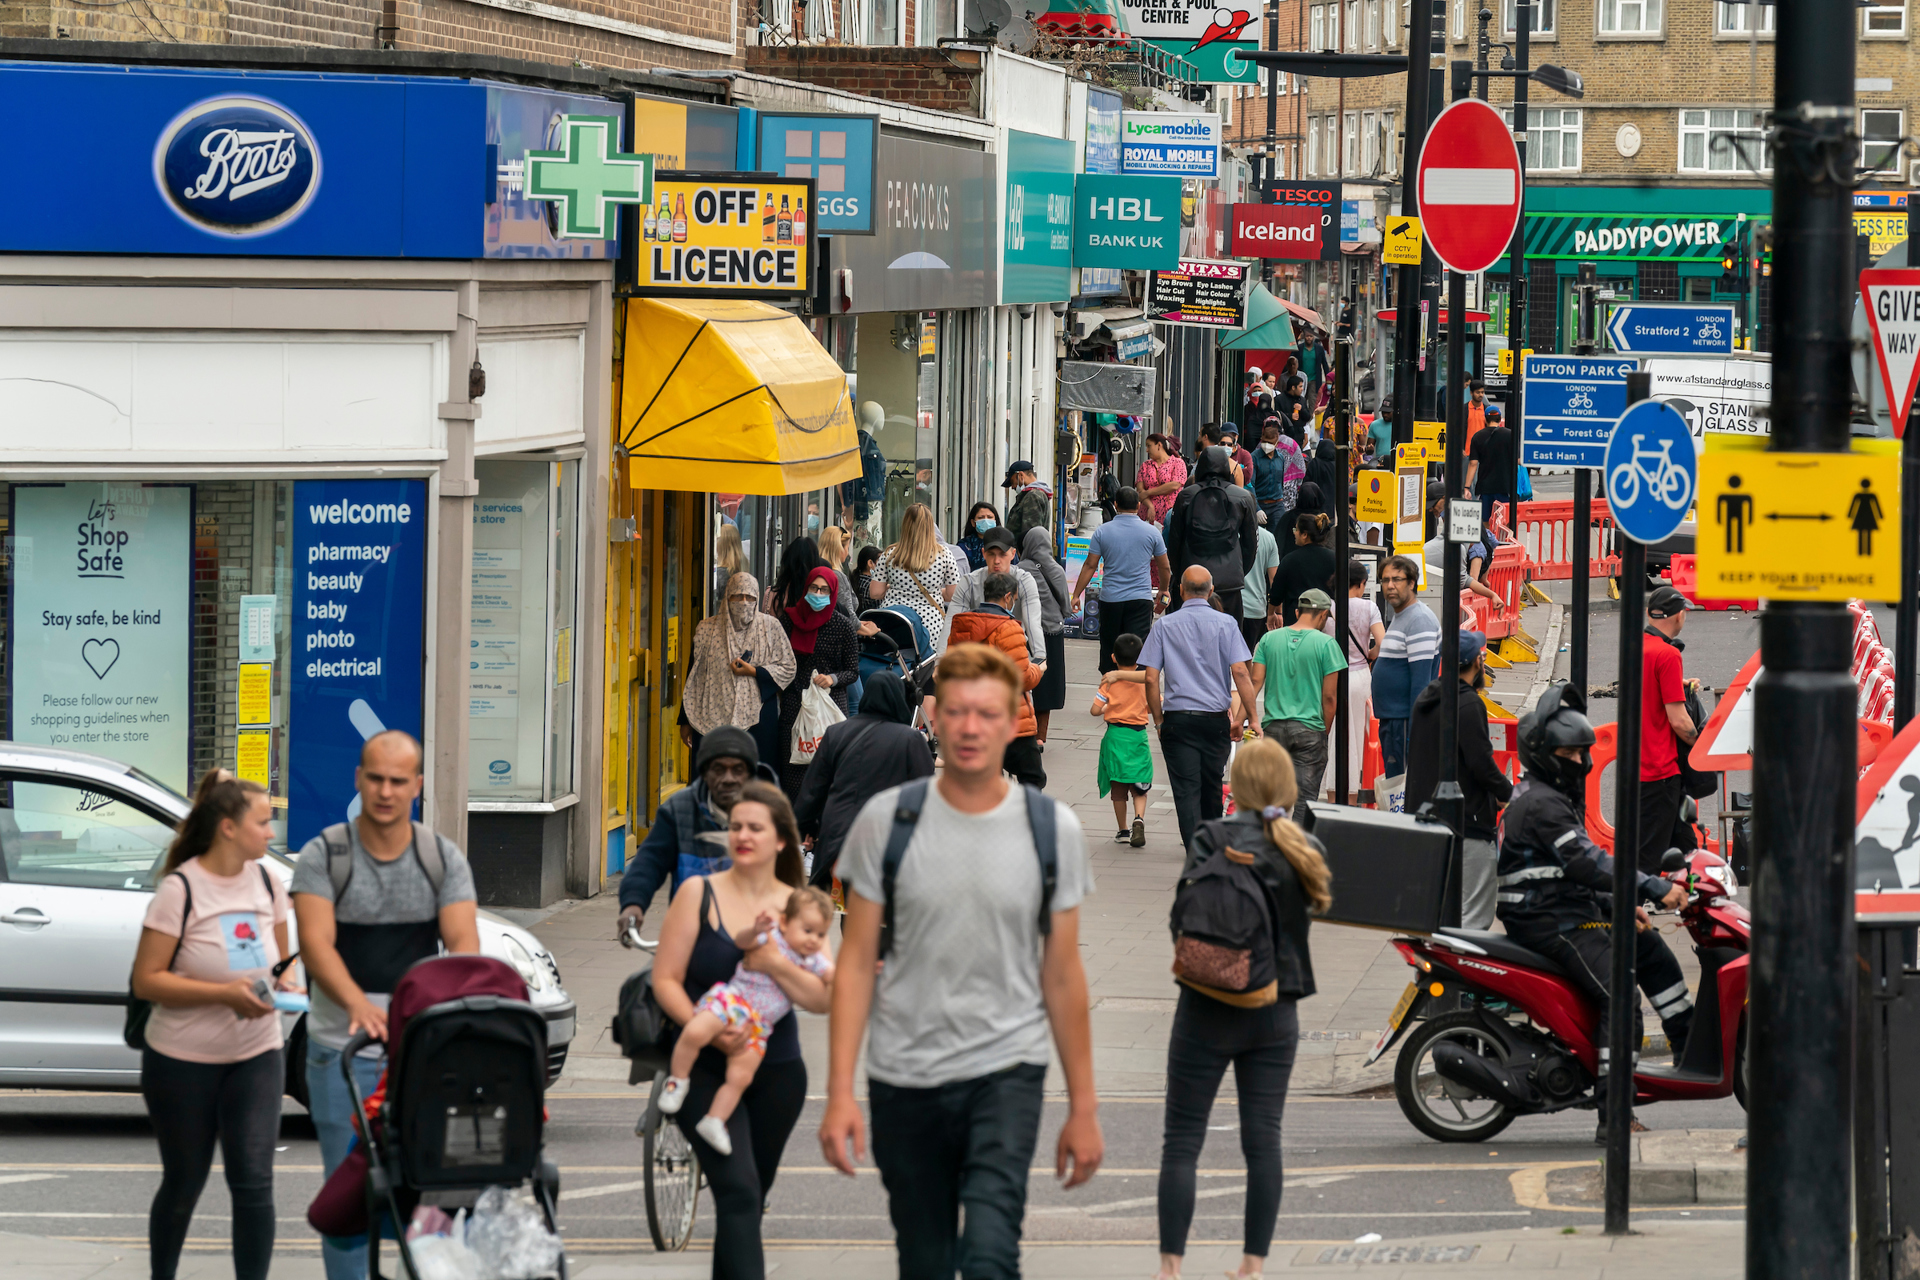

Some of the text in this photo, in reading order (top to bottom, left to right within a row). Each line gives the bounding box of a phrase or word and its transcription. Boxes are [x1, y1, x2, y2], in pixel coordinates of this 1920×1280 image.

[1141, 9, 1190, 24] CENTRE
[1127, 119, 1212, 136] Lycamobile
[1123, 147, 1214, 163] ROYAL MOBILE
[184, 129, 297, 201] Boots
[1148, 162, 1182, 170] UNLOCKING
[1187, 163, 1211, 171] REPAIRS
[1272, 188, 1333, 202] TESCO
[692, 188, 758, 225] OFF
[887, 180, 950, 231] PEACOCKS
[1090, 196, 1165, 222] HBL
[1008, 184, 1025, 251] HBL
[1238, 221, 1315, 242] Iceland
[1089, 234, 1164, 249] BANK UK
[652, 247, 797, 284] LICENCE
[1156, 286, 1185, 295] Hair Cut
[1195, 289, 1231, 298] Hair Colour
[1196, 281, 1234, 290] Eye Lashes
[1156, 294, 1185, 304] Waxing
[1195, 297, 1226, 306] Highlights
[1877, 289, 1920, 322] GIVE
[1695, 315, 1725, 323] LONDON
[1634, 325, 1690, 337] Stratford 2
[1887, 333, 1917, 354] WAY
[1531, 363, 1615, 376] UPTON PARK
[1565, 385, 1597, 393] LONDON
[1562, 408, 1598, 416] NETWORK
[1563, 428, 1592, 438] Forest
[1705, 417, 1758, 433] GLASS
[1533, 451, 1585, 461] East Ham 1
[482, 503, 522, 513] services
[1362, 506, 1387, 514] Suspension
[1366, 498, 1383, 506] Parking
[88, 499, 116, 528] Let's
[309, 498, 412, 524] welcome
[1453, 506, 1480, 520] No loading
[480, 515, 506, 524] store
[77, 523, 129, 553] Shop
[77, 548, 123, 571] Safe
[308, 541, 391, 564] pharmacy
[307, 571, 364, 593] beauty
[1719, 571, 1875, 587] KEEP YOUR DISTANCE
[307, 600, 348, 622] baby
[42, 609, 161, 630] Stay safe, be kind
[306, 629, 356, 652] photo
[306, 657, 382, 678] electrical
[42, 693, 158, 707] Please follow our new
[31, 711, 170, 729] shopping guidelines when
[50, 731, 149, 745] you enter the store
[1457, 957, 1508, 976] VISION
